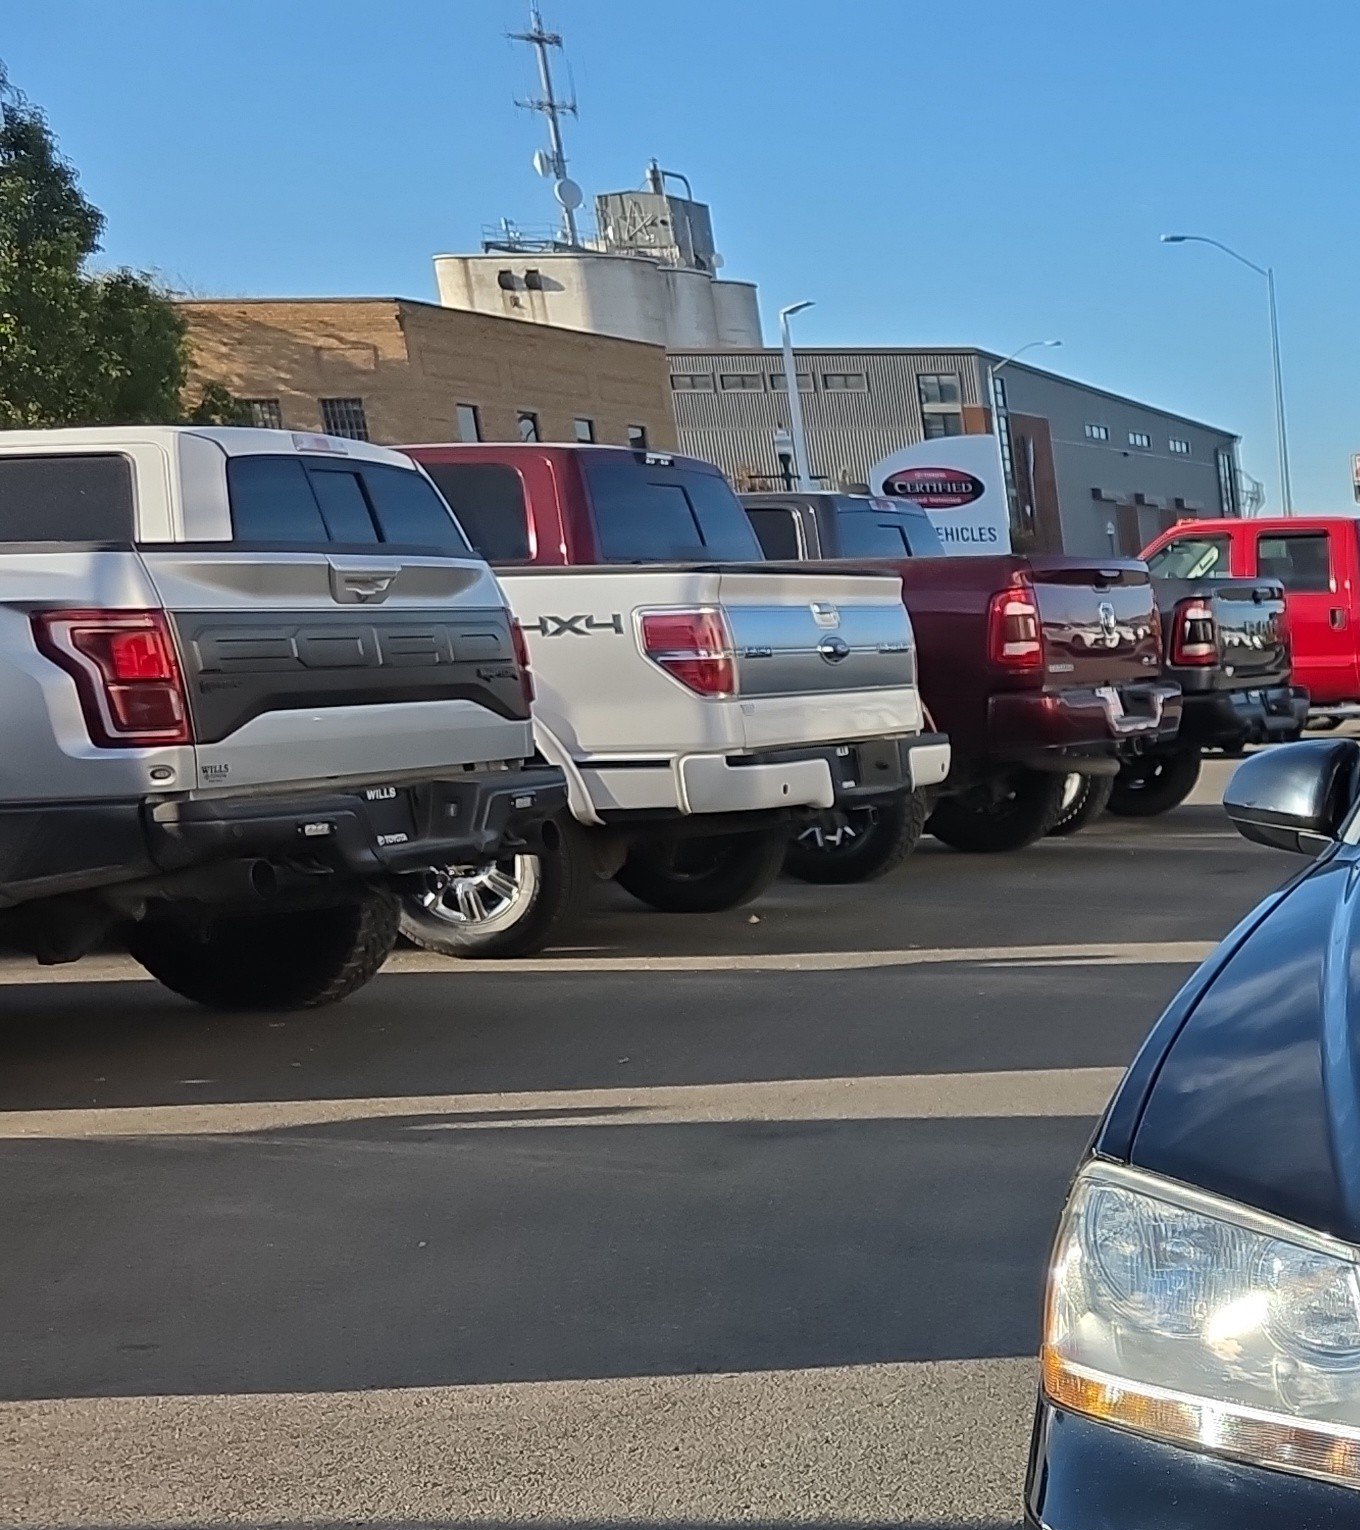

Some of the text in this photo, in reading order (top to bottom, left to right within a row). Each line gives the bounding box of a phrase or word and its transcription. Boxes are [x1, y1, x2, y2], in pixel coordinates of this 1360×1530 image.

[894, 481, 973, 494] CERTIFIED
[936, 526, 997, 543] EHICLES
[366, 787, 396, 800] WILLS
